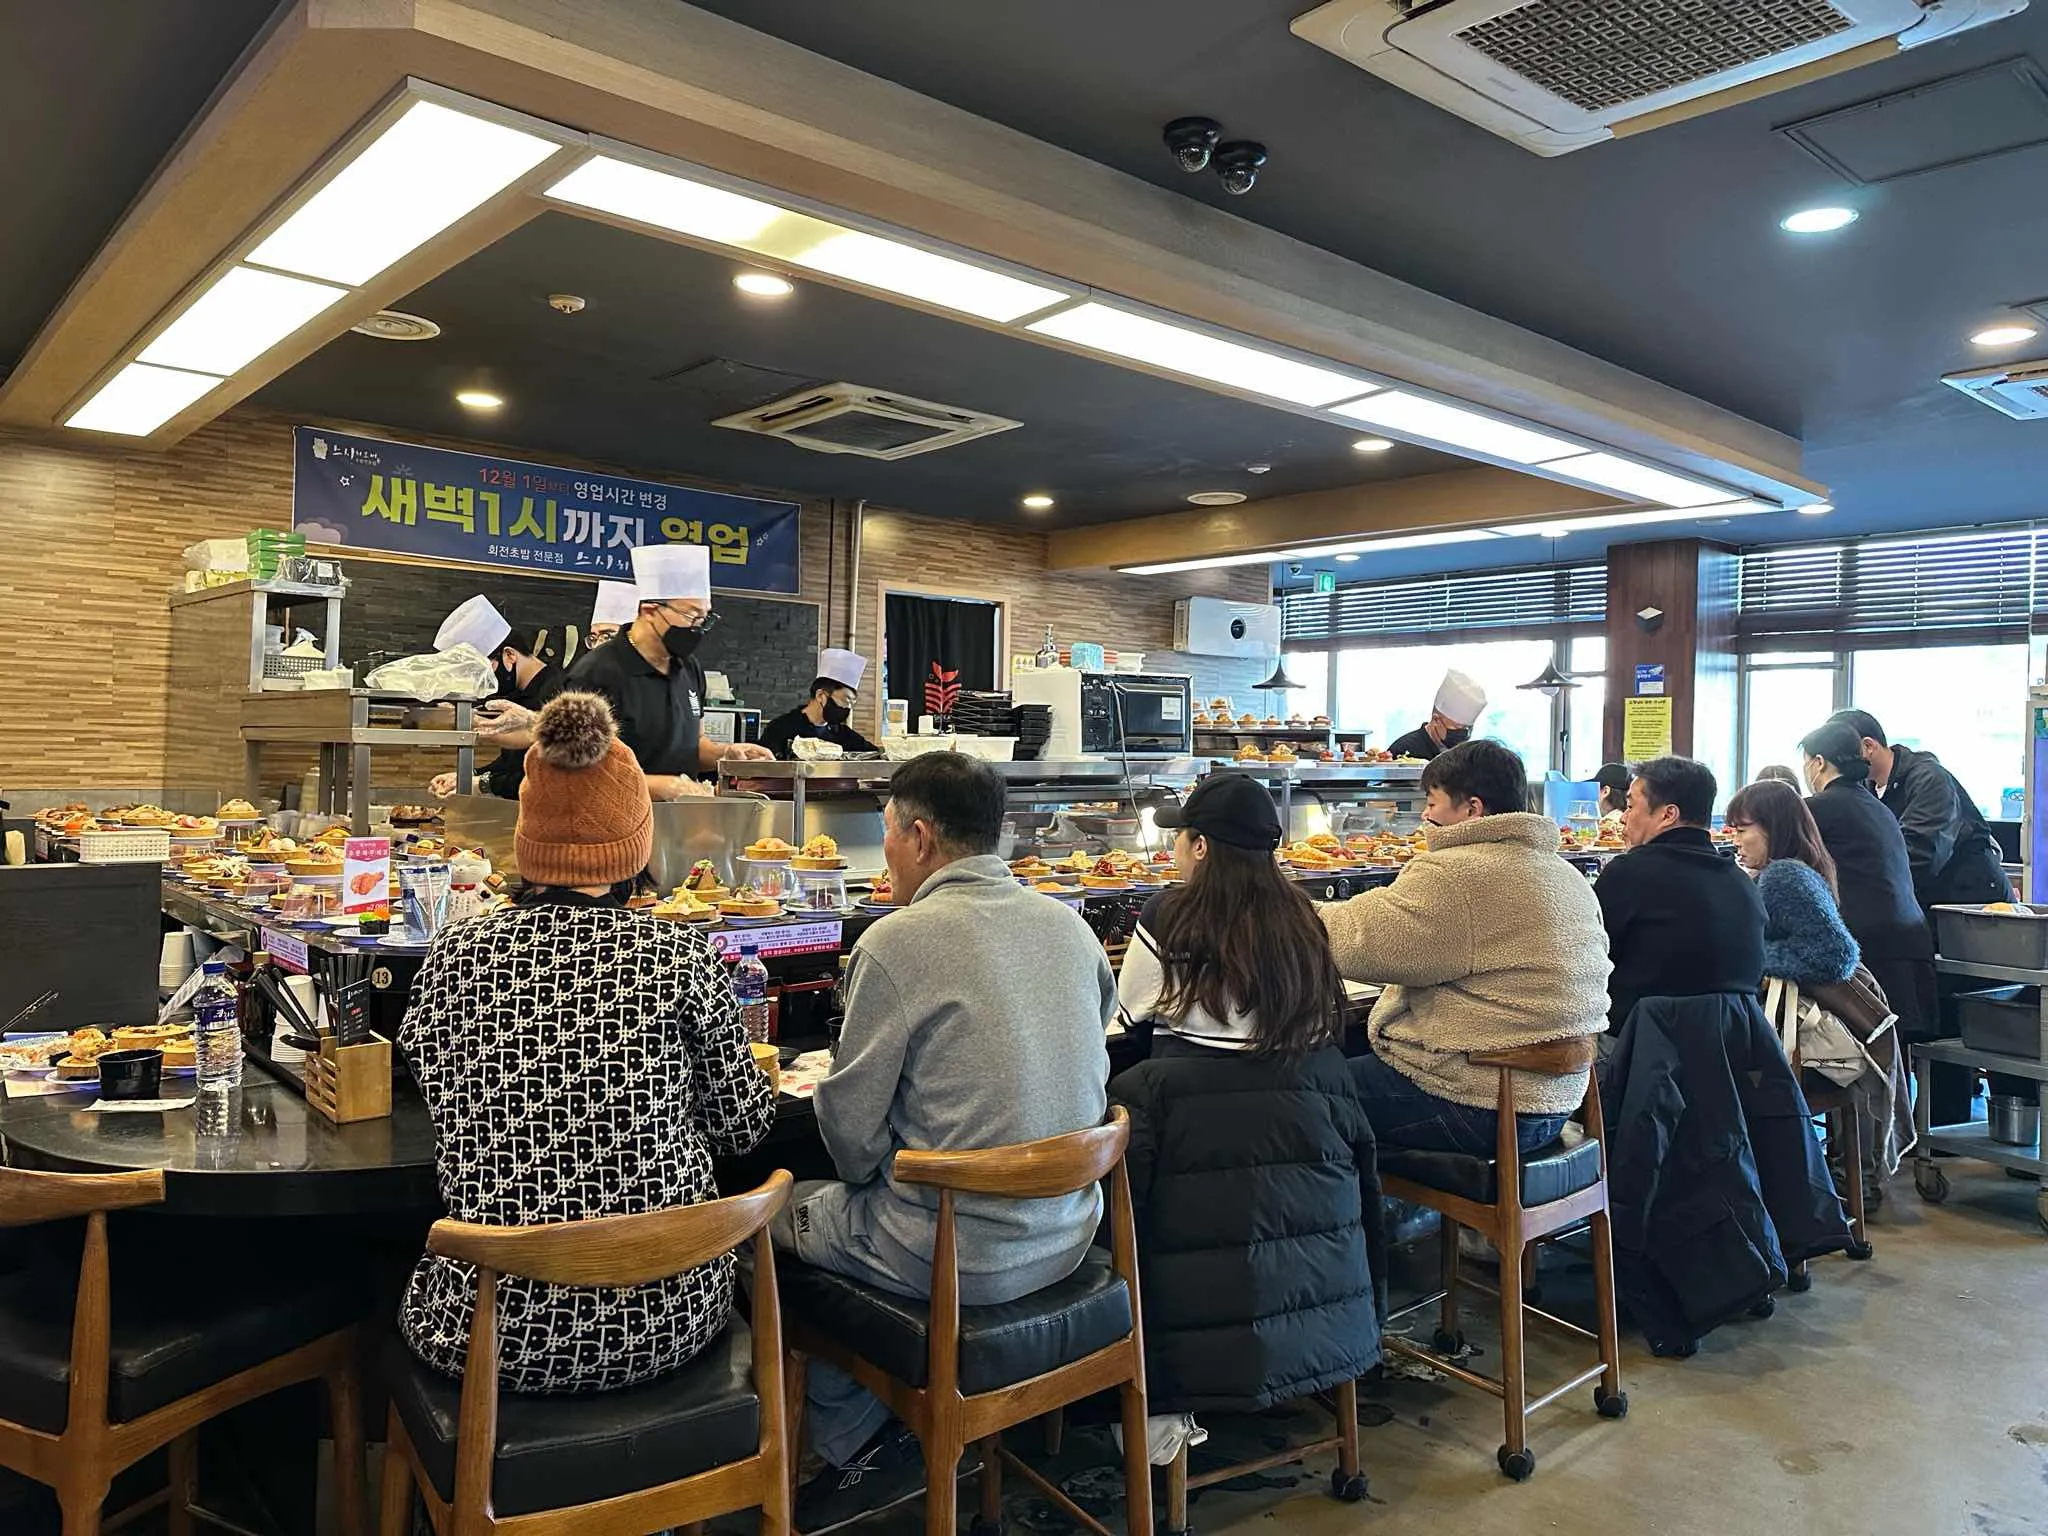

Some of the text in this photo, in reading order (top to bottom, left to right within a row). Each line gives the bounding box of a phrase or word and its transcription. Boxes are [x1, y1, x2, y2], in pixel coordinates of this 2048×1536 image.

[479, 467, 516, 489] 12월
[574, 481, 636, 506] 영업시간
[639, 491, 668, 511] 변경
[487, 544, 530, 561] 회전초밥
[533, 550, 565, 564] 전문점
[375, 971, 390, 985] 13
[798, 1204, 811, 1234] DKNY
